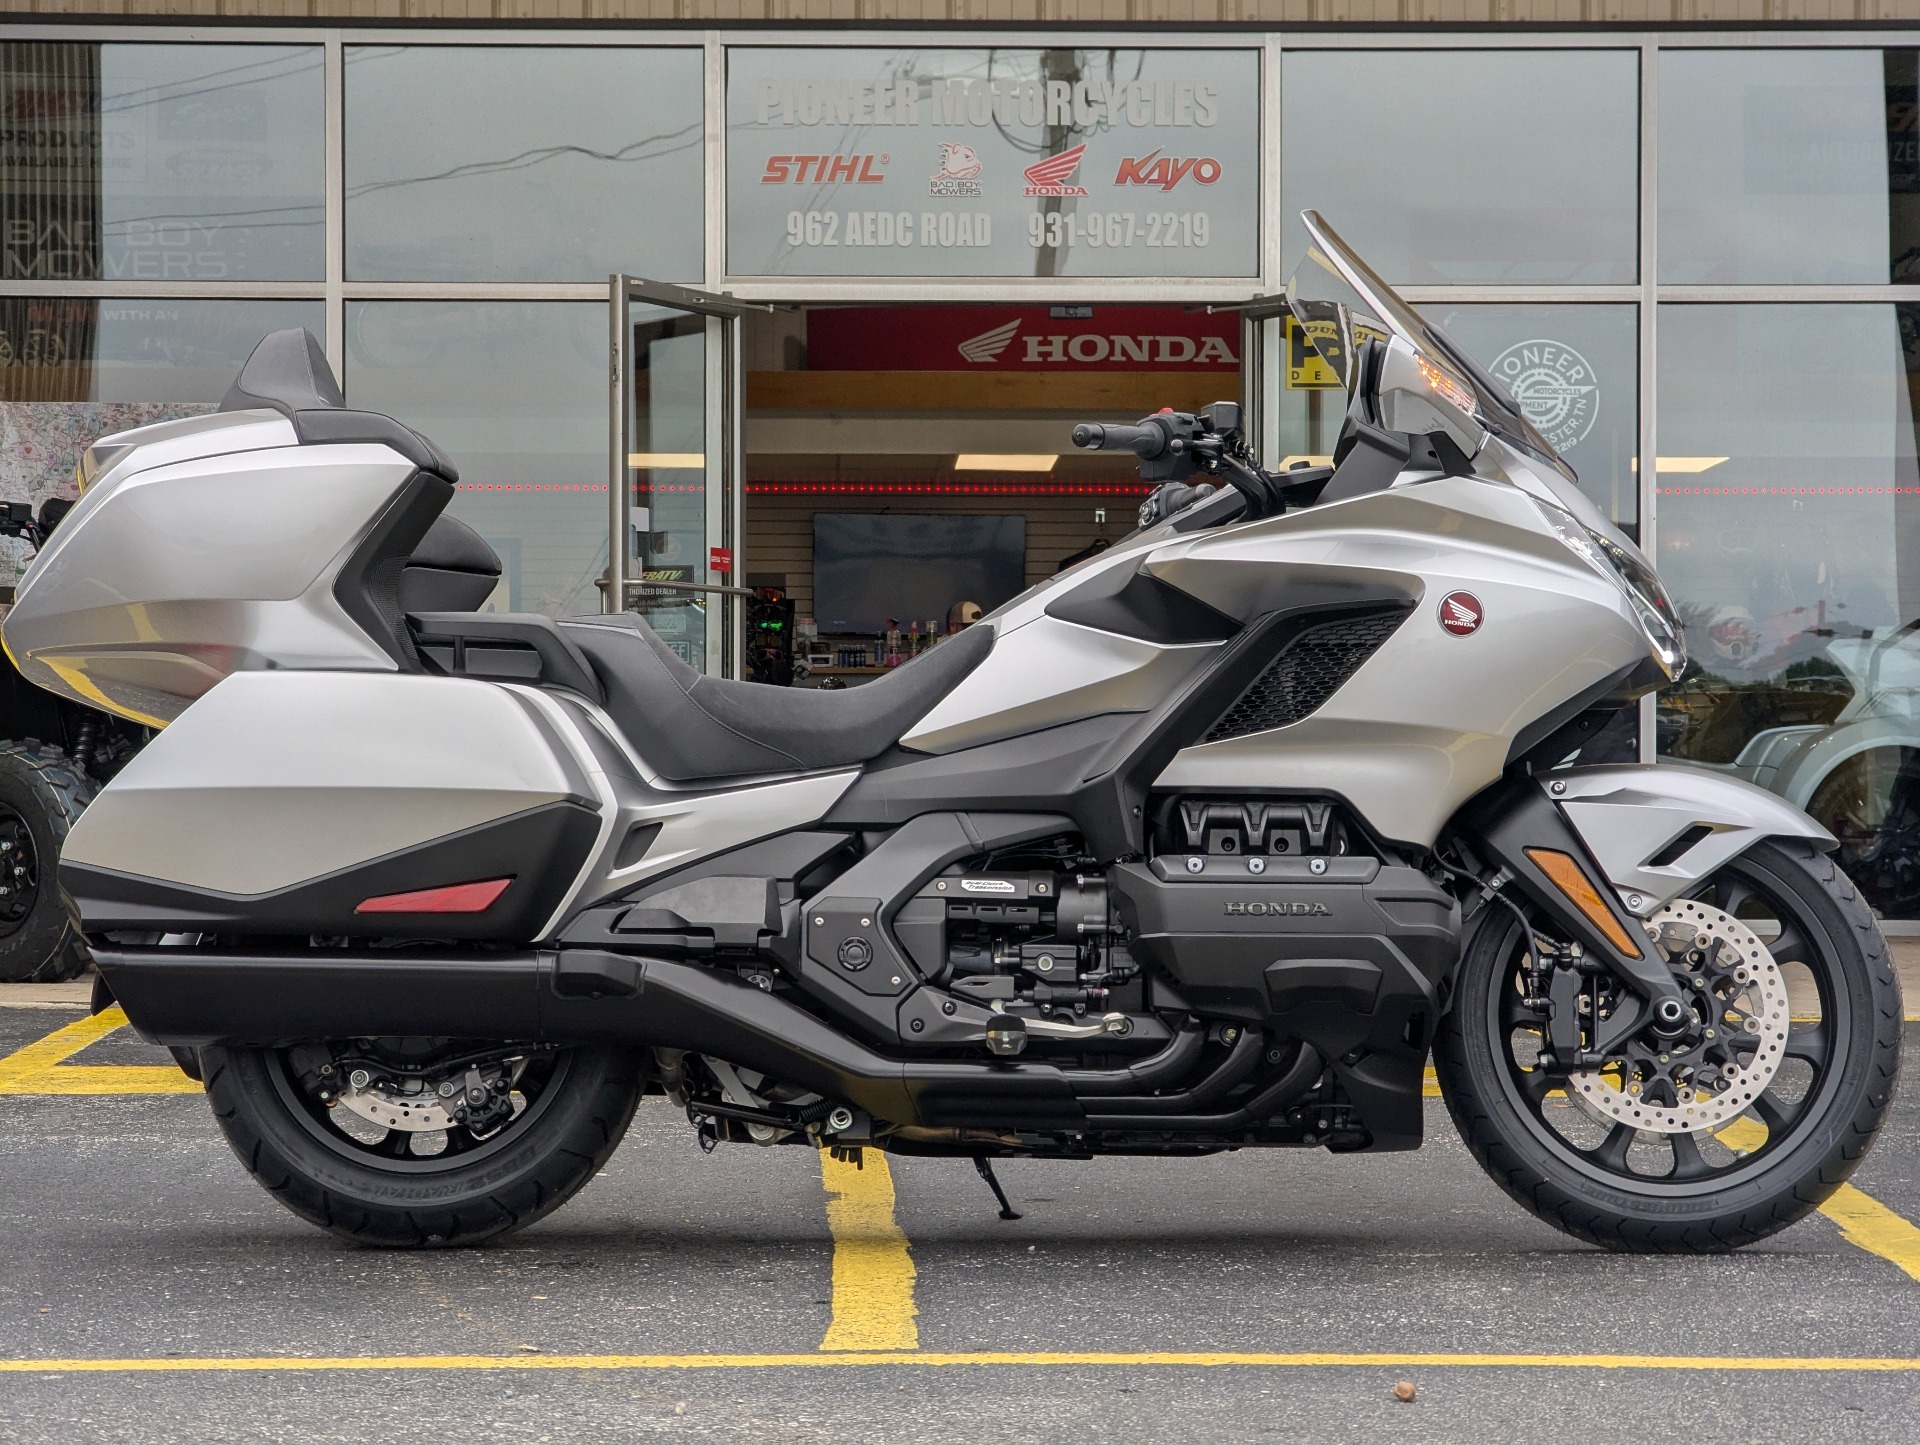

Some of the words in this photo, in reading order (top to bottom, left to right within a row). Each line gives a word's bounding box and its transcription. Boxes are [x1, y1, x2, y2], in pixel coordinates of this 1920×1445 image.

[757, 78, 919, 126] PIONEER
[931, 78, 1219, 128] MOTORCYCLES
[761, 154, 886, 184] STIHL
[1114, 146, 1222, 192] KAYO
[930, 181, 954, 189] BAD
[957, 181, 982, 189] BOY
[930, 188, 982, 196] MOWERS
[1023, 186, 1088, 197] HONDA
[125, 219, 226, 247] BOY
[787, 212, 839, 247] 962
[844, 212, 914, 247] AEDC
[921, 212, 991, 247] ROAD
[1028, 211, 1210, 248] 931-967-2219
[5, 250, 228, 278] MOWERS
[103, 309, 150, 321] WITH
[153, 309, 180, 321] AN
[1022, 334, 1240, 363] HONDA
[1533, 387, 1582, 396] MOTORCYCLES
[1443, 618, 1477, 629] HONDA
[1224, 901, 1333, 917] HONDA
